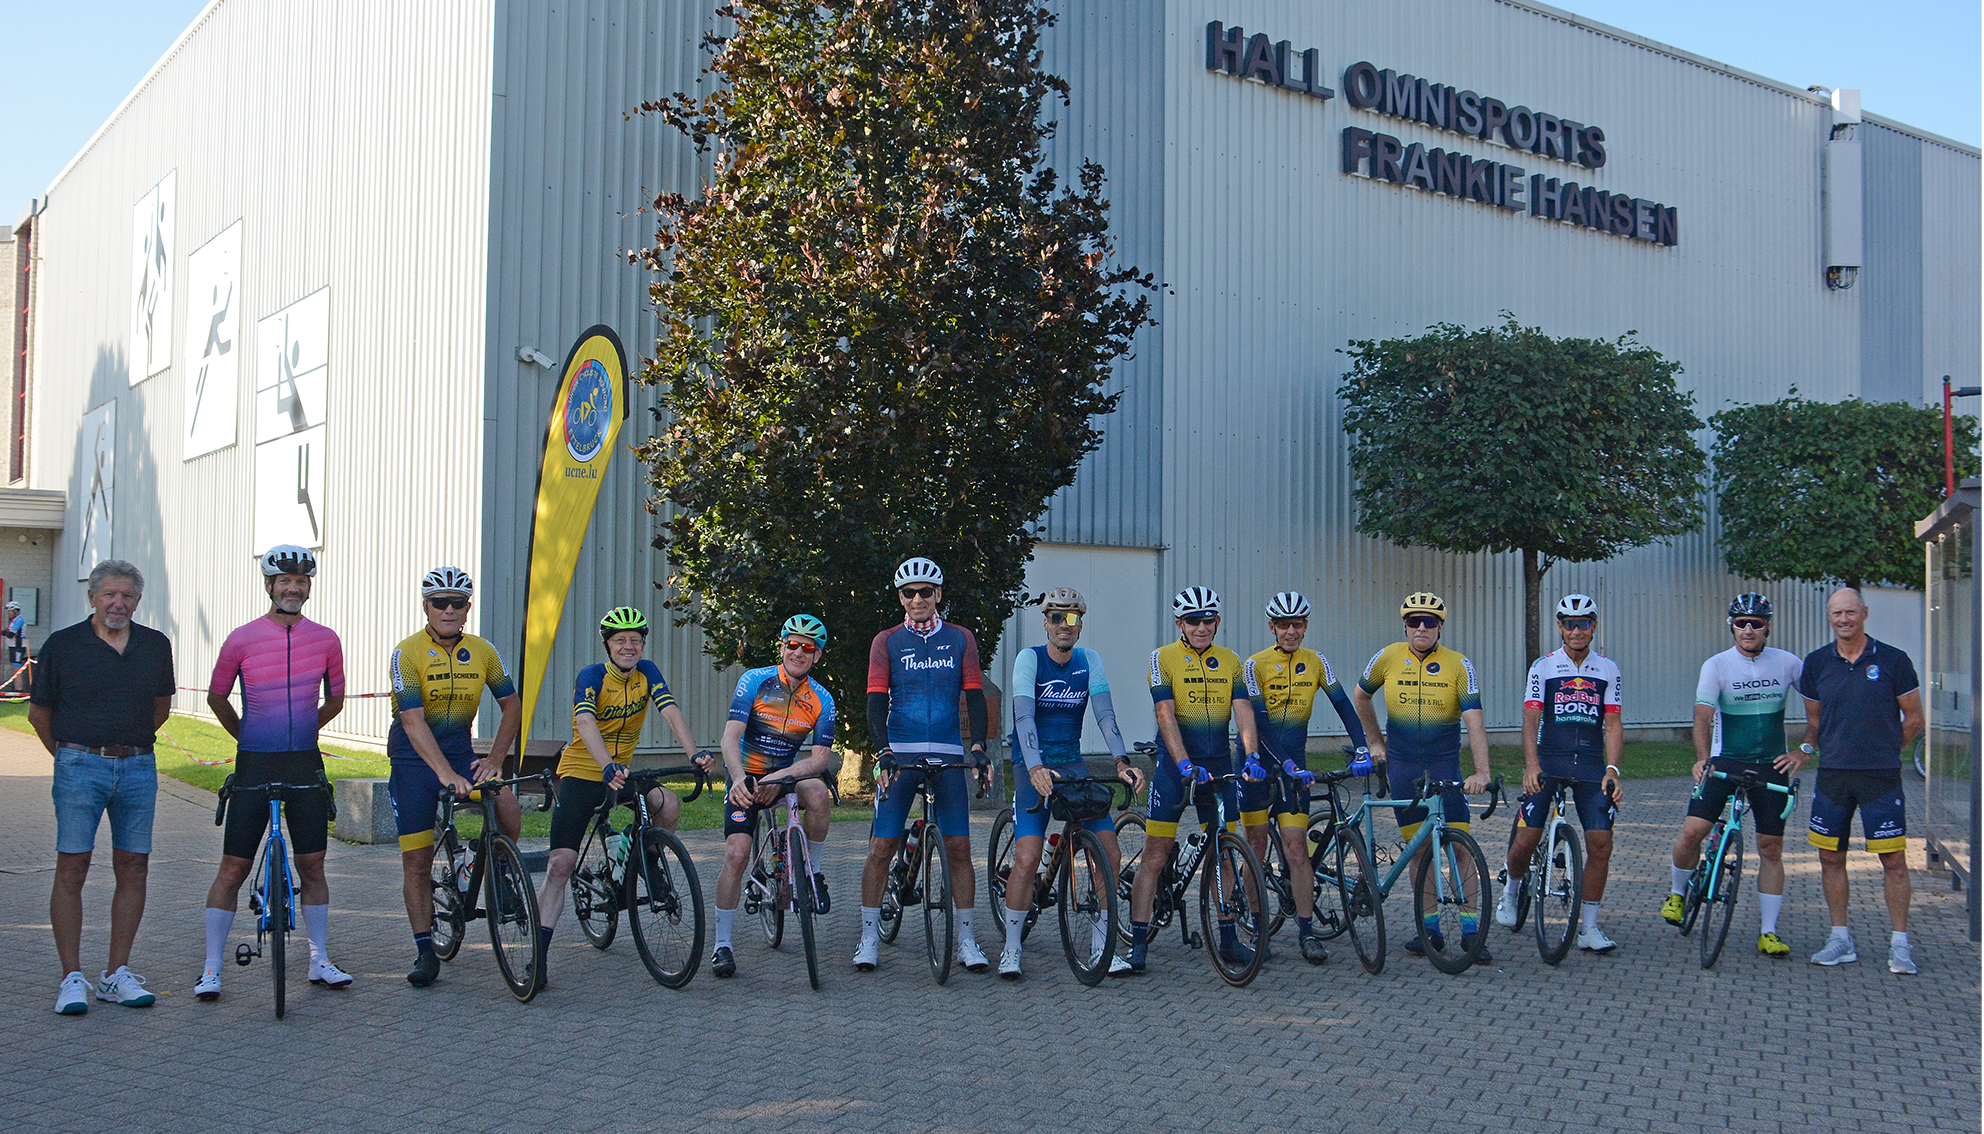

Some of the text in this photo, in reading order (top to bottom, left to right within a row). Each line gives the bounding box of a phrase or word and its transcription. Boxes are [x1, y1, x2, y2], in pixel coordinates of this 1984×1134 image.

[1206, 20, 1606, 169] HALL OMNISPORTS
[1343, 126, 1678, 246] FRANKIE HANSEN
[568, 428, 602, 453] ETTELBRUCK
[565, 465, 598, 479] ucne.lu
[900, 653, 955, 671] Thailand
[453, 672, 479, 680] SCHIEREN
[736, 668, 773, 698] opti-vue
[1732, 678, 1781, 690] SKODA
[1532, 674, 1540, 699] BOSS
[1554, 702, 1599, 718] BORA
[1555, 715, 1597, 724] hansgrohe
